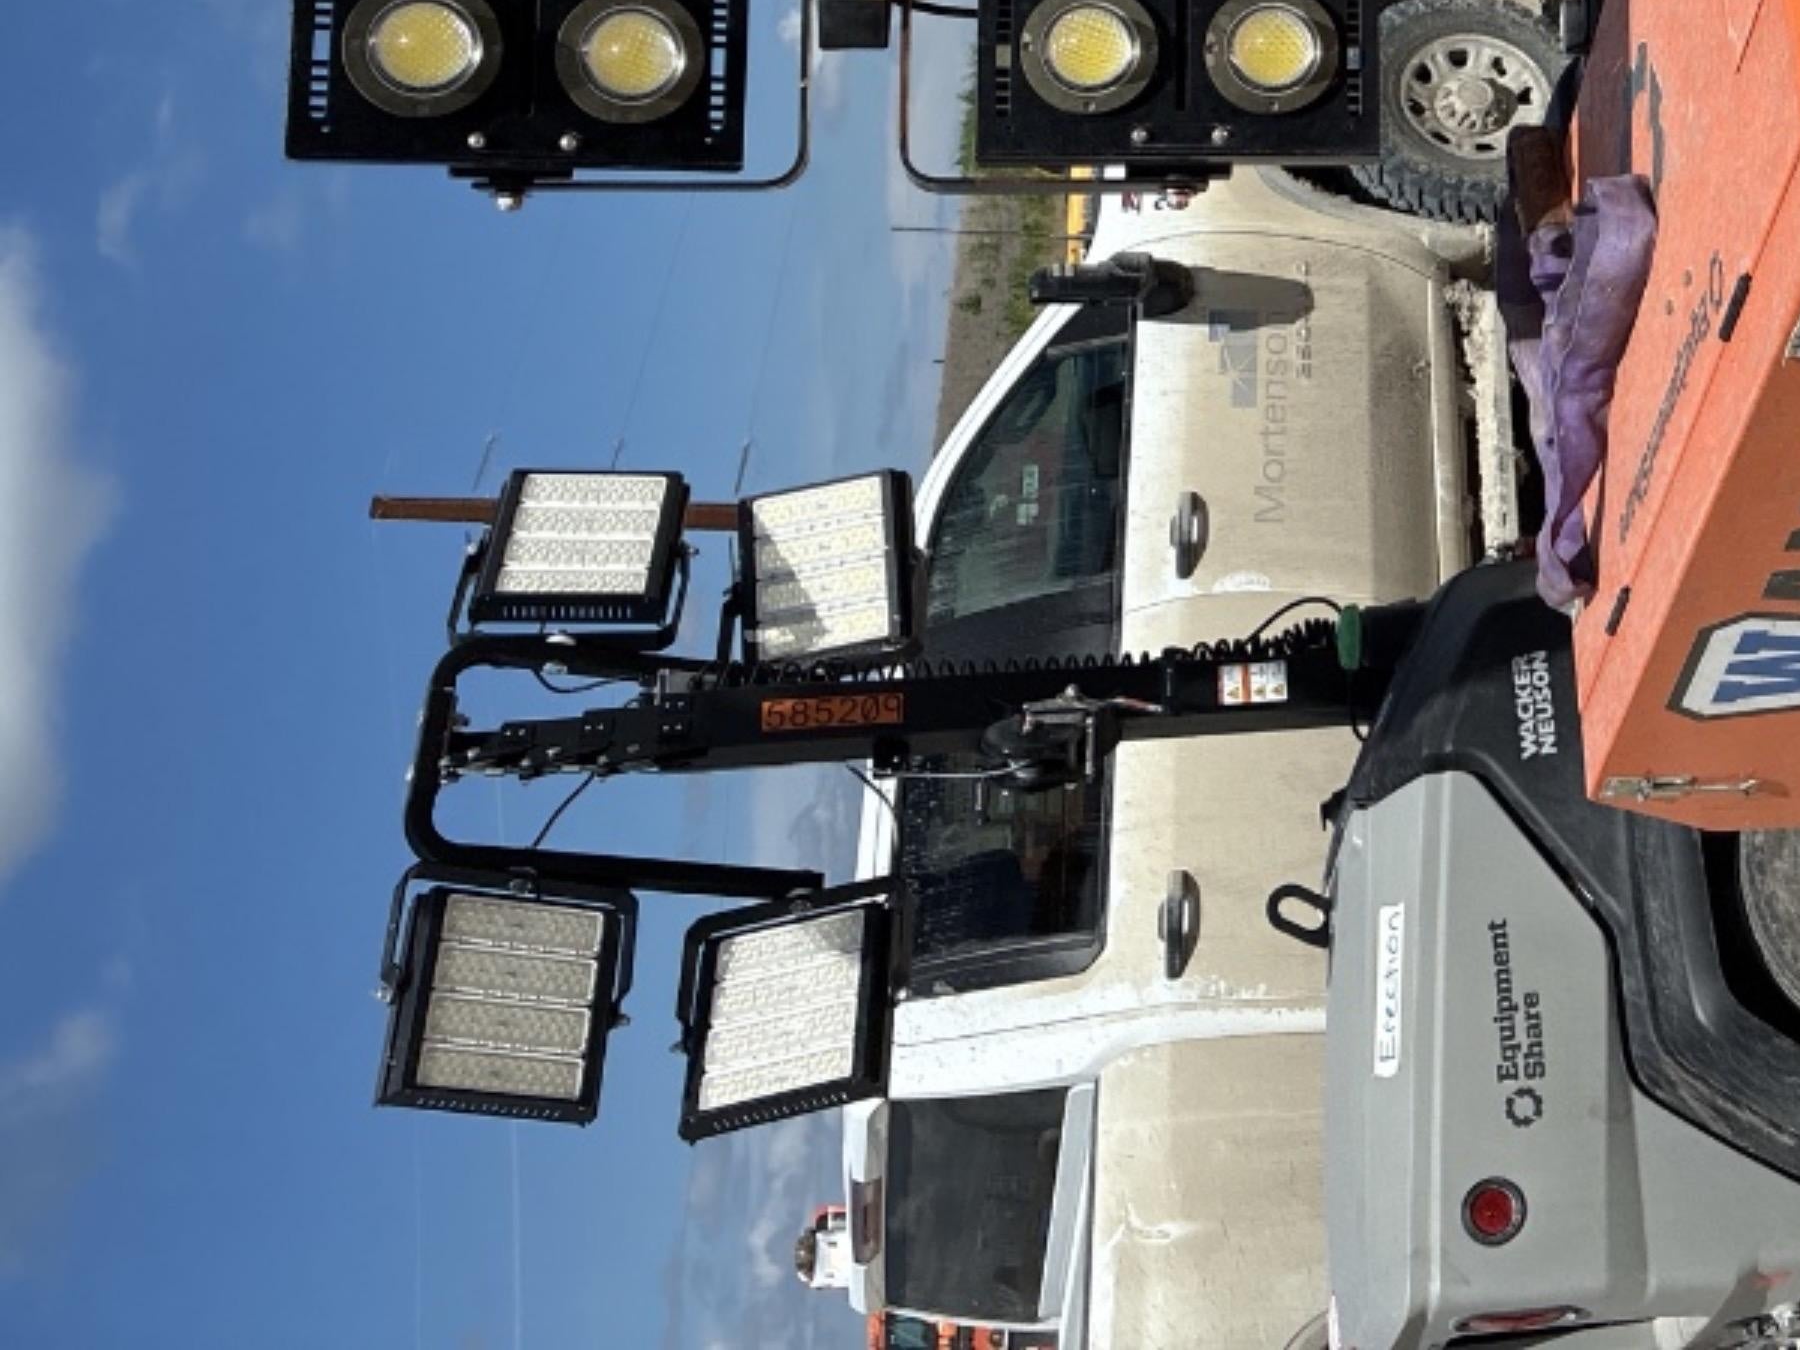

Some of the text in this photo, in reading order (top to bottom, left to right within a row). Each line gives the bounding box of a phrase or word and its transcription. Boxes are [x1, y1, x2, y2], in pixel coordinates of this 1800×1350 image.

[1254, 310, 1288, 523] Mortenson
[1512, 653, 1538, 760] WACKER
[1528, 650, 1558, 755] NEUSON
[1378, 910, 1400, 1063] Erection
[1488, 918, 1522, 1083] Equipment
[1523, 991, 1546, 1080] Share
